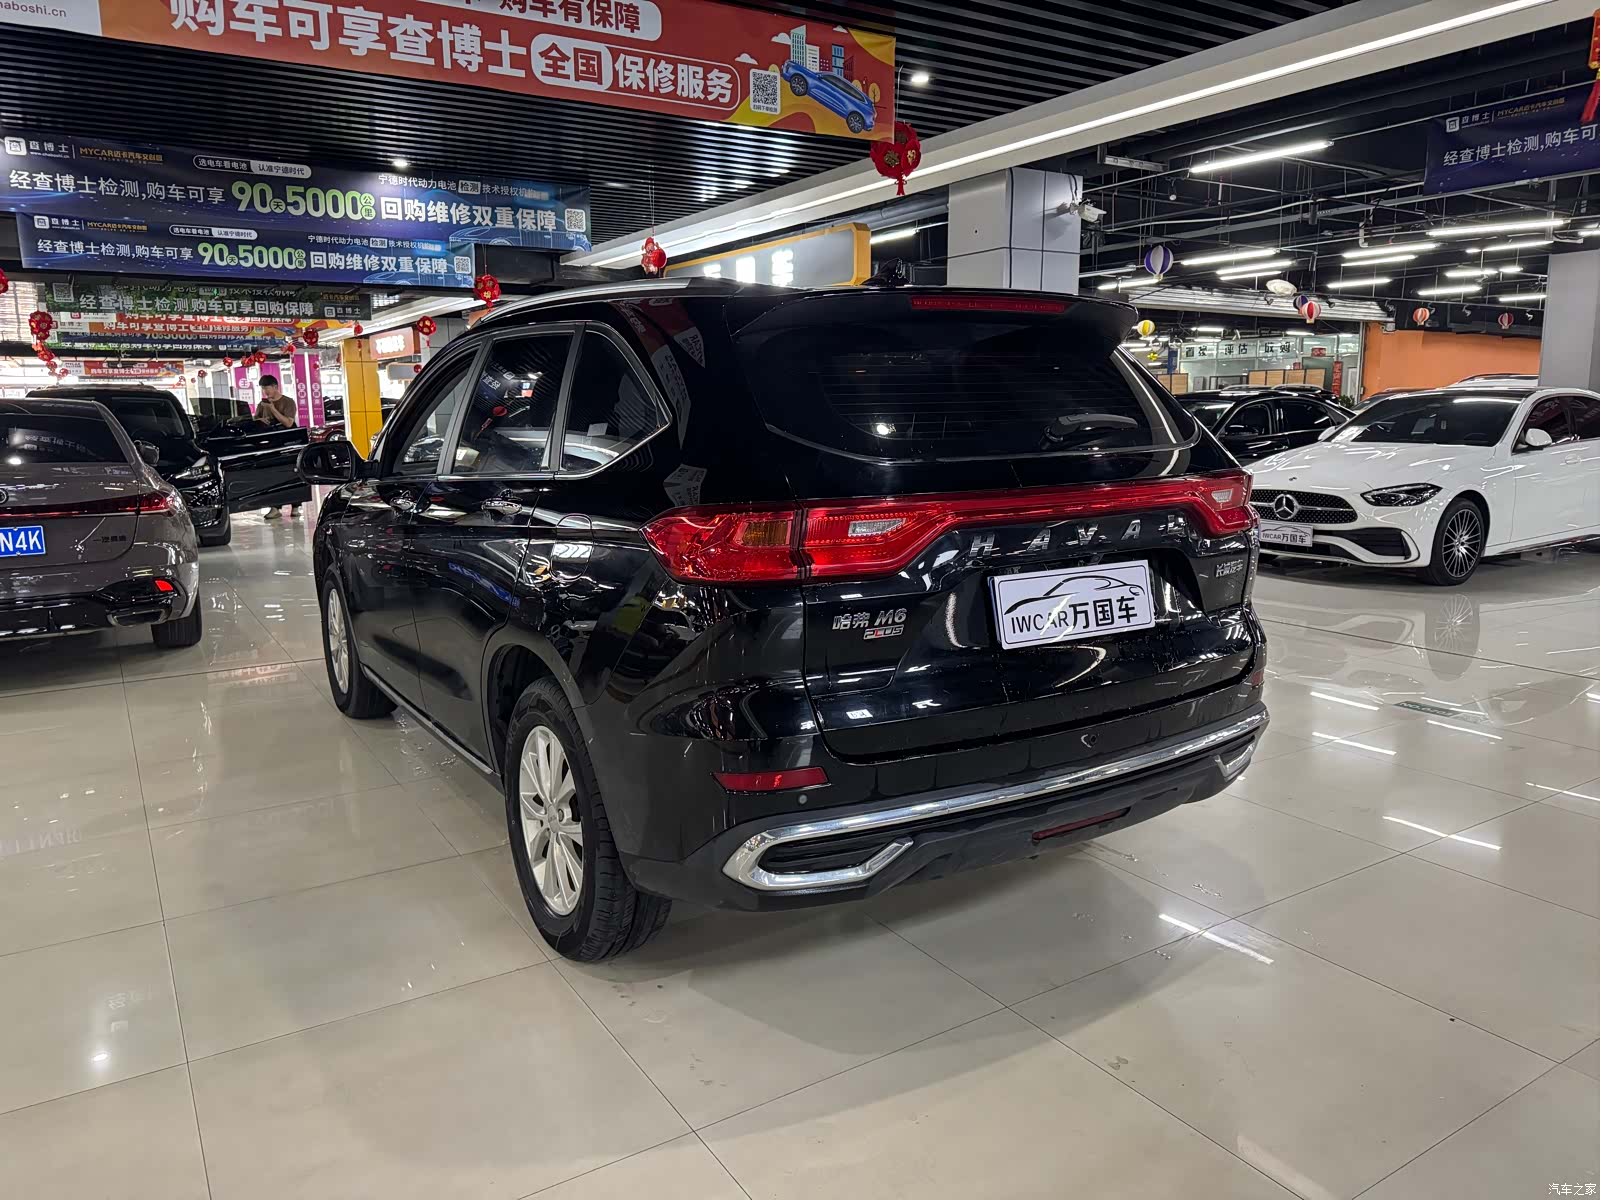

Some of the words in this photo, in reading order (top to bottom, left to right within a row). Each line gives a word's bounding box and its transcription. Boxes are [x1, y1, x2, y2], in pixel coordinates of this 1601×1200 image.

[614, 53, 734, 104] 保修服务
[1443, 124, 1599, 167] 经查博士检测,购车可
[9, 169, 226, 205] 经查博士检测,购车可享
[380, 196, 556, 232] 回购维修双重保障
[37, 239, 194, 261] 经查博士检测,购车可享
[310, 251, 448, 275] 回购维修双重保障
[79, 293, 314, 317] 经查博士检测购车可享回购保障
[0, 529, 43, 552] N4K
[969, 512, 1185, 557] HAVAL
[832, 611, 871, 630] 哈弗
[874, 607, 908, 626] M6
[863, 624, 905, 640] PLUS
[1010, 595, 1138, 635] IWCAR万国车
